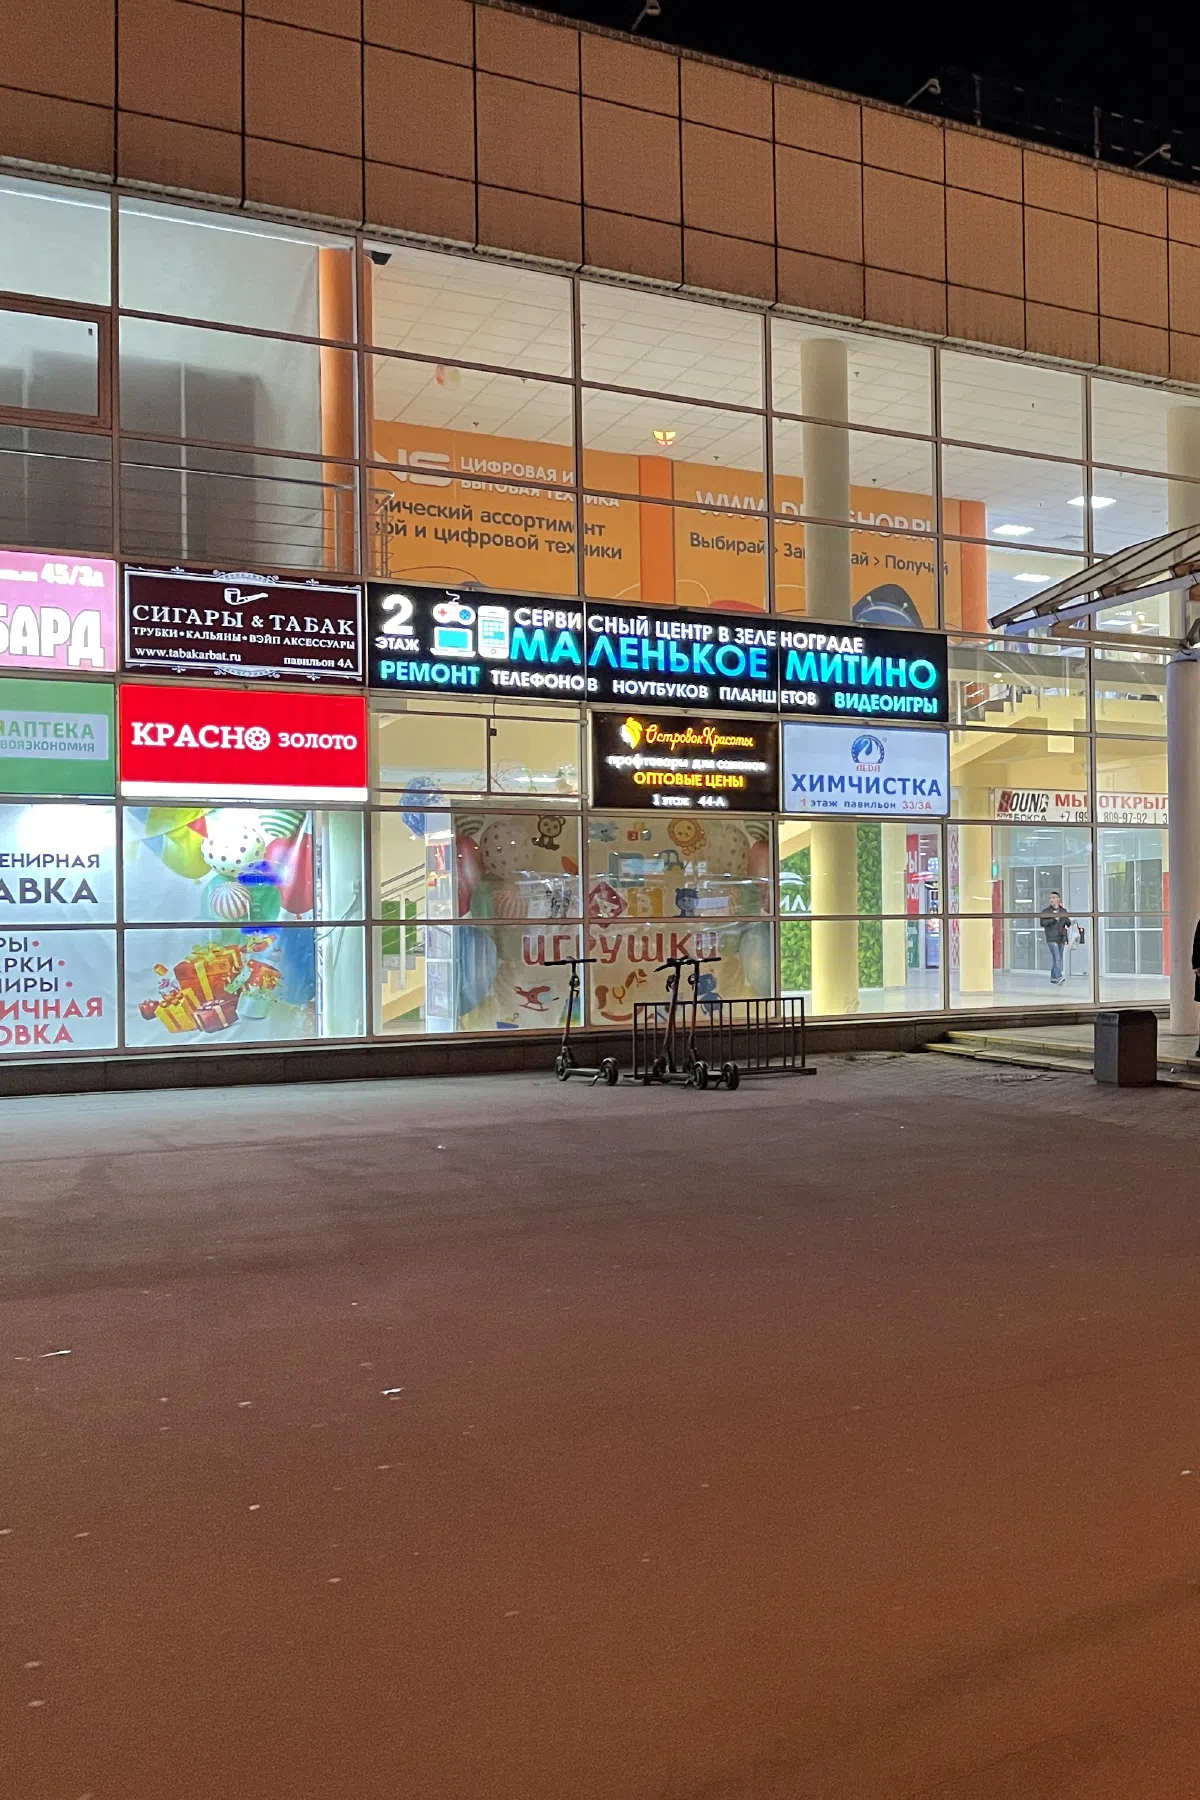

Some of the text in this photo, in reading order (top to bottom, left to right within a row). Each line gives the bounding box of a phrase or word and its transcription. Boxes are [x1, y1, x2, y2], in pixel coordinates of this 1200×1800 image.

[460, 456, 574, 485] ЦИФРОВАЯ И
[480, 509, 605, 537] ассортимнт
[415, 527, 426, 538] и
[434, 529, 539, 551] цифровой
[690, 532, 766, 556] Выбирай
[132, 605, 355, 635] СИГАРЫ & ТАБАК
[381, 593, 414, 636] 2
[513, 607, 863, 654] СЕРВИСНЫЙ ЦЕНТР В ЗЕЛЕНОГРАДЕ
[283, 637, 355, 650] АКСЕССУАРЫ
[375, 636, 420, 651] ЭТАЖ
[135, 646, 242, 662] www.tabakarbat.ru
[283, 657, 354, 669] павильон 4А
[510, 627, 937, 690] МАЛЕНЬКОЕ МИТИНО
[380, 659, 938, 714] РЕМОНТ ТЕЛЕФОНОВ НОУТБУКОВ ПЛАНШЕТОВ ВИДЕОИГРЫ
[633, 772, 744, 788] ОПТОВЫЕ ЦЕНЫ
[791, 774, 942, 796] ХИМЧИСТКА
[652, 794, 659, 805] 1
[801, 799, 807, 807] 1
[810, 799, 838, 808] этаж
[844, 801, 896, 809] павильон
[1098, 794, 1168, 810] ОТКРЫЛ
[0, 957, 53, 973] РКИ
[0, 977, 59, 993] ИРЫ
